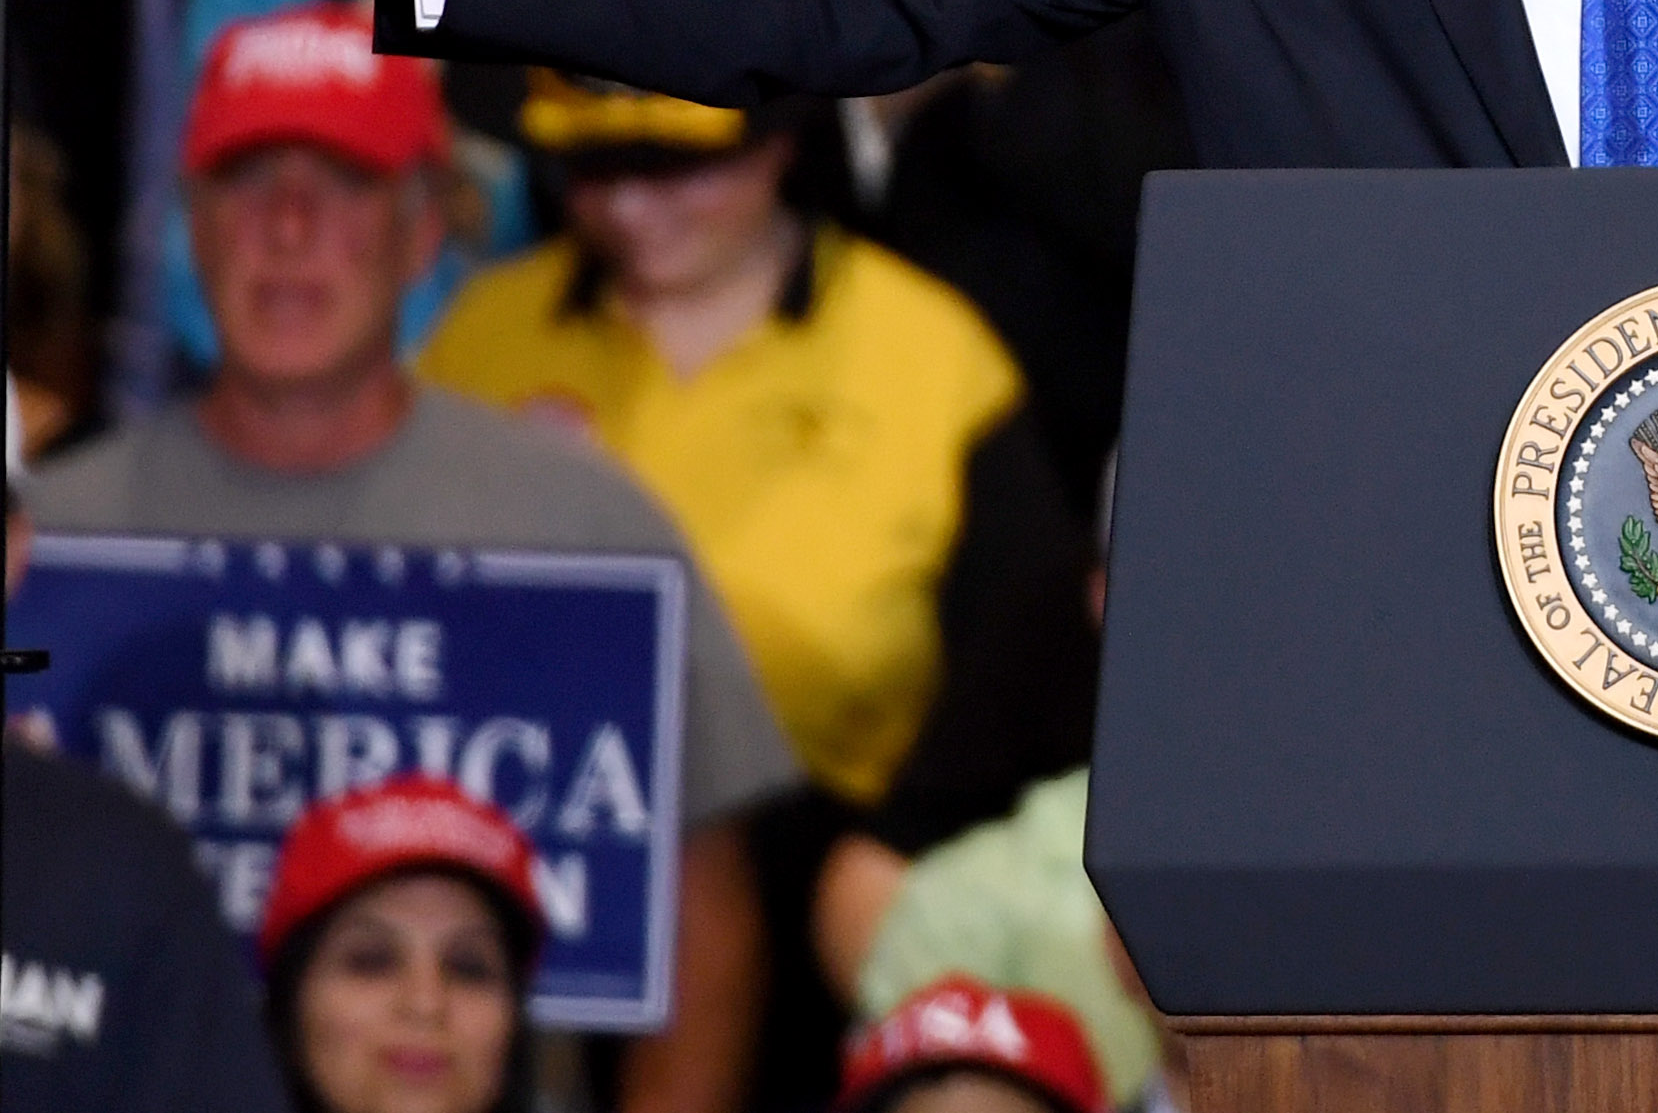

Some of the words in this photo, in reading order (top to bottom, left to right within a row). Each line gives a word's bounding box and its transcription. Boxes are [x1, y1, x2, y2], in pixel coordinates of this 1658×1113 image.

[1517, 519, 1552, 584] THE
[1535, 591, 1571, 631] OF
[207, 614, 444, 699] MAKE
[98, 702, 650, 835] MERICA
